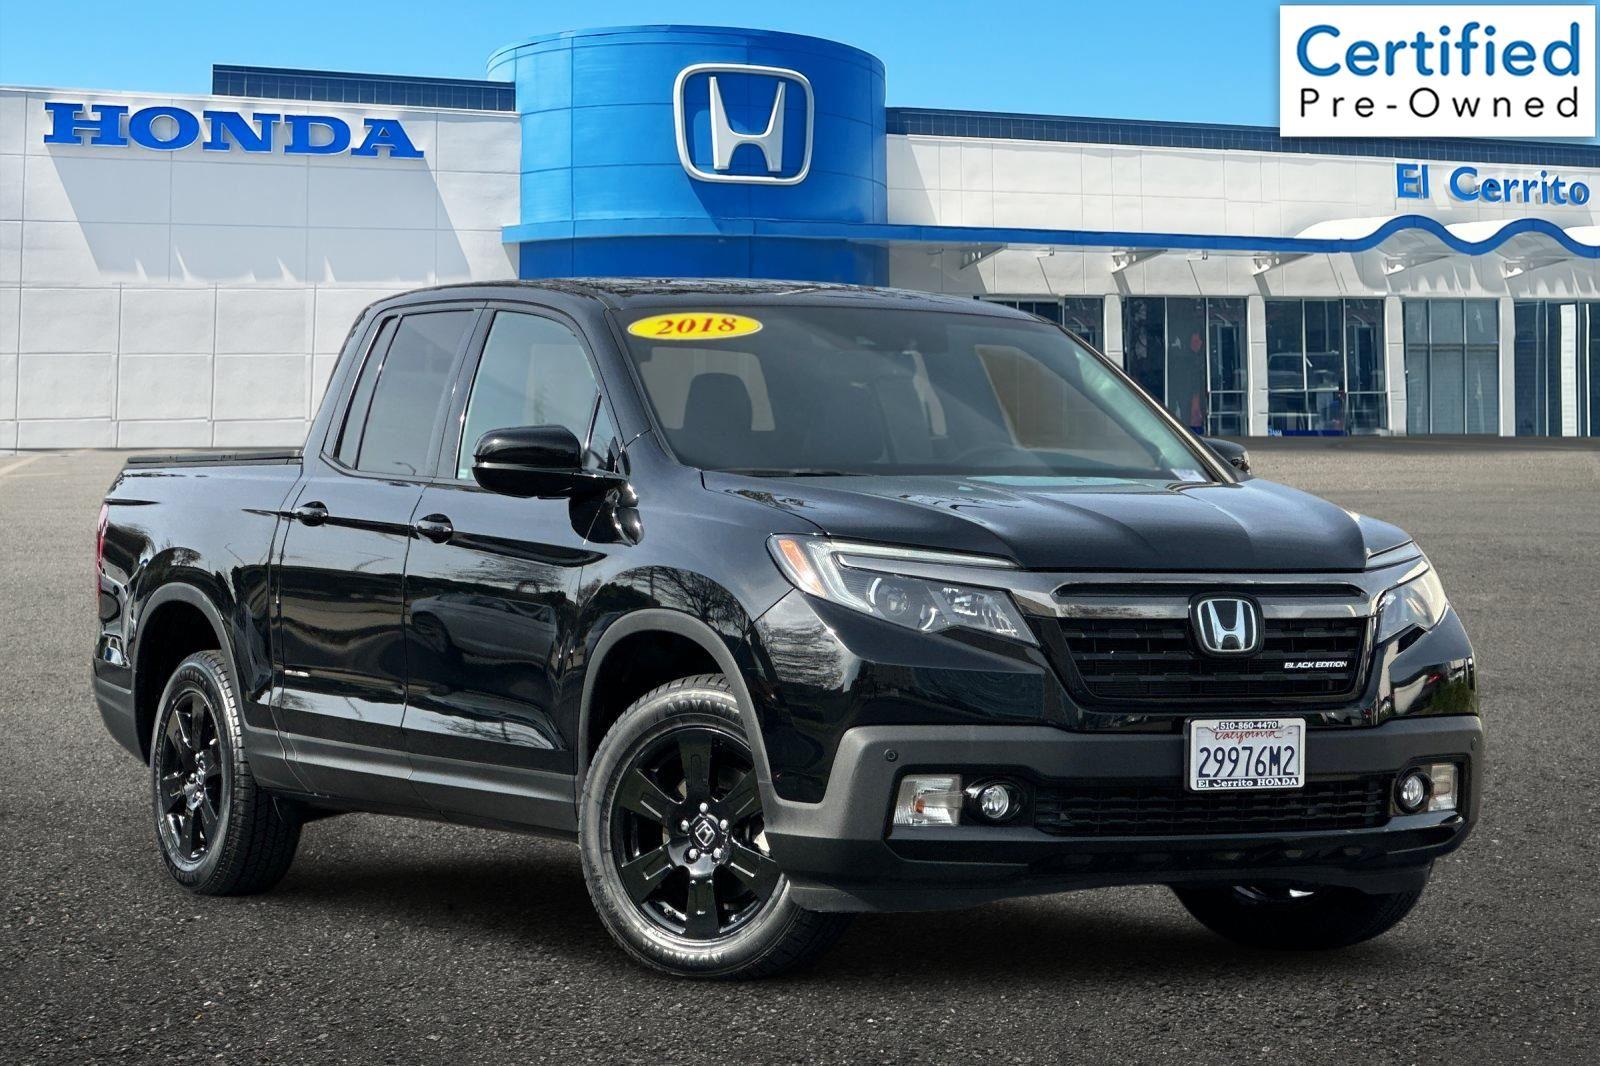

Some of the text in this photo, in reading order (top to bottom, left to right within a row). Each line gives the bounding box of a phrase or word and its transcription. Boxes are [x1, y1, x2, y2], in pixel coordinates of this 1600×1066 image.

[43, 101, 425, 159] HONDA
[1396, 163, 1591, 206] El Cerrito
[655, 317, 737, 336] 2018
[1284, 660, 1348, 669] BLACK EDITION
[1198, 745, 1296, 778] 29976M2
[1197, 779, 1209, 788] El
